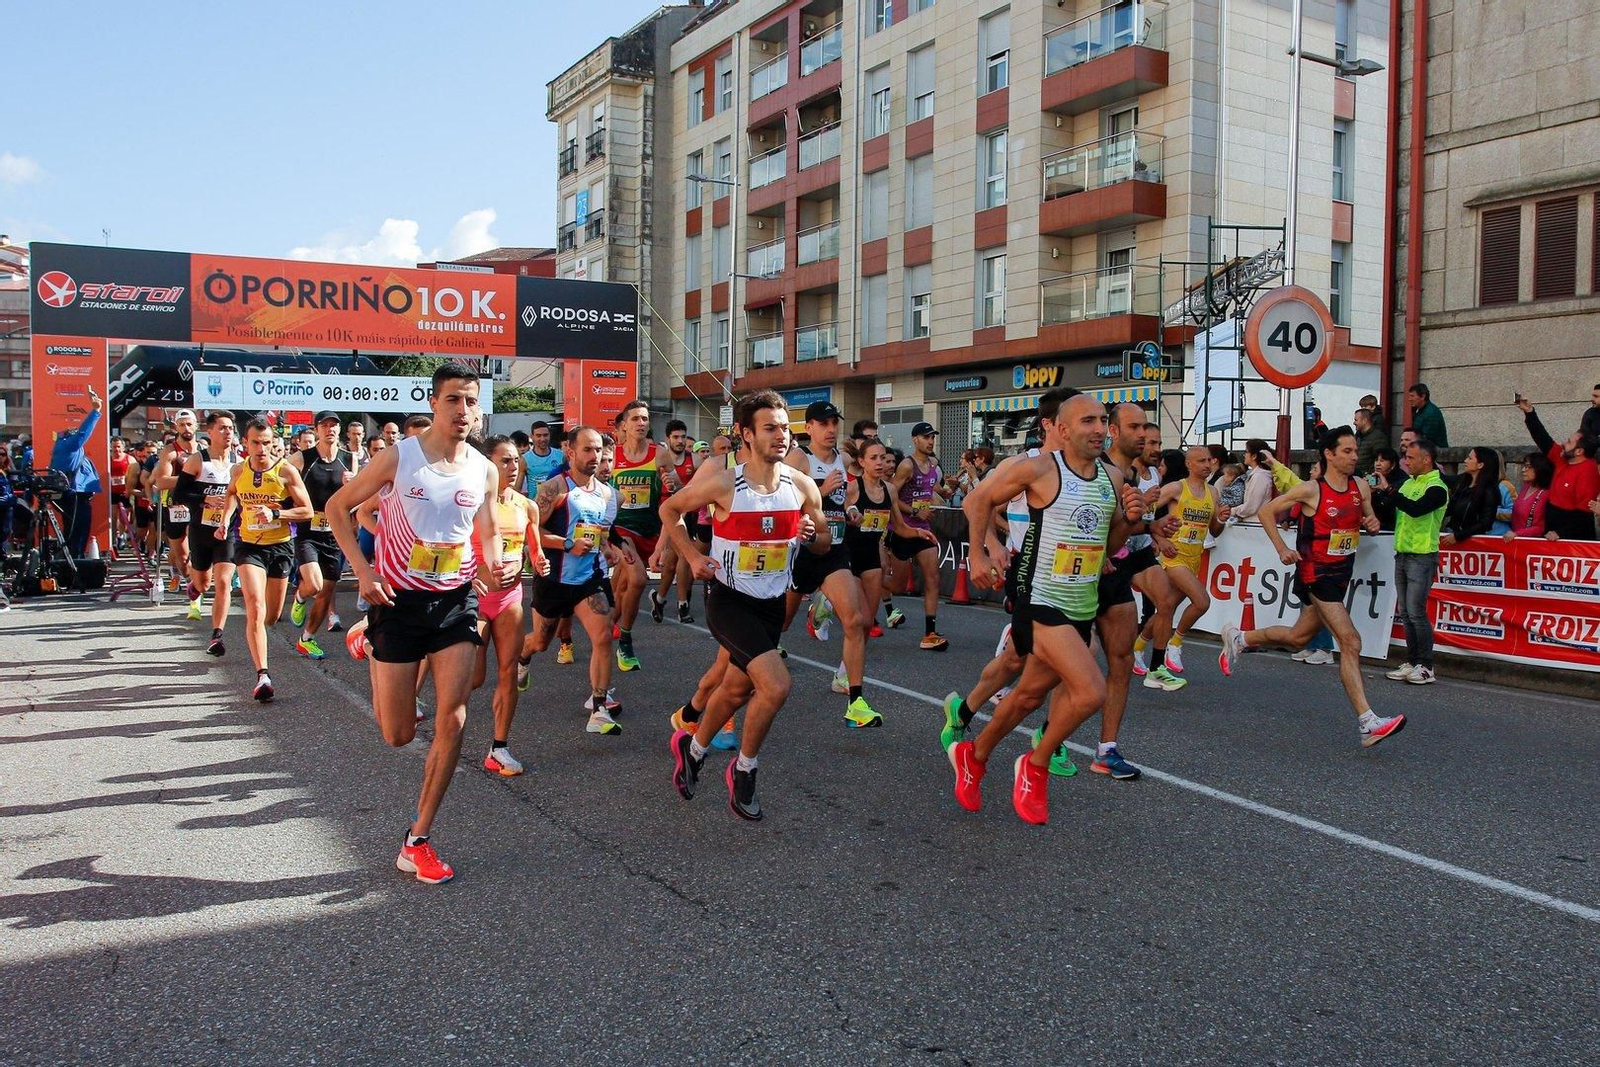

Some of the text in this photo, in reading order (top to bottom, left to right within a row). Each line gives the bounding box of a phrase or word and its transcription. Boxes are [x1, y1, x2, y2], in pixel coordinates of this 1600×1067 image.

[79, 282, 184, 303] staroil
[80, 301, 176, 313] ESTACIONES DE SERVICIO
[540, 306, 611, 323] RODOSA
[417, 319, 504, 334] dezquilómetros
[557, 323, 596, 331] ALPINE
[226, 326, 485, 349] Posiblemente o 10K máis rápido de Galicia
[1267, 321, 1318, 355] 40
[1013, 364, 1058, 389] Bippy
[1132, 361, 1168, 382] Bippy
[253, 379, 314, 396] O Porriño
[322, 386, 399, 401] 00:00:02
[630, 493, 637, 504] 8
[173, 510, 187, 519] 260
[872, 517, 879, 528] 9
[1188, 530, 1198, 540] 18
[1338, 537, 1352, 550] 48
[1016, 522, 1036, 582] PINARIUM
[432, 555, 439, 572] 1
[756, 554, 766, 571] 5
[1072, 557, 1083, 575] 6
[1439, 552, 1501, 577] FROIZ
[1529, 557, 1599, 585] FROIZ
[1451, 578, 1498, 588] www.froiz.com
[1544, 584, 1594, 595] www.froiz.com
[1438, 601, 1501, 626] FROIZ
[1450, 625, 1497, 636] www.froiz.com
[1527, 614, 1599, 644] FROIZ
